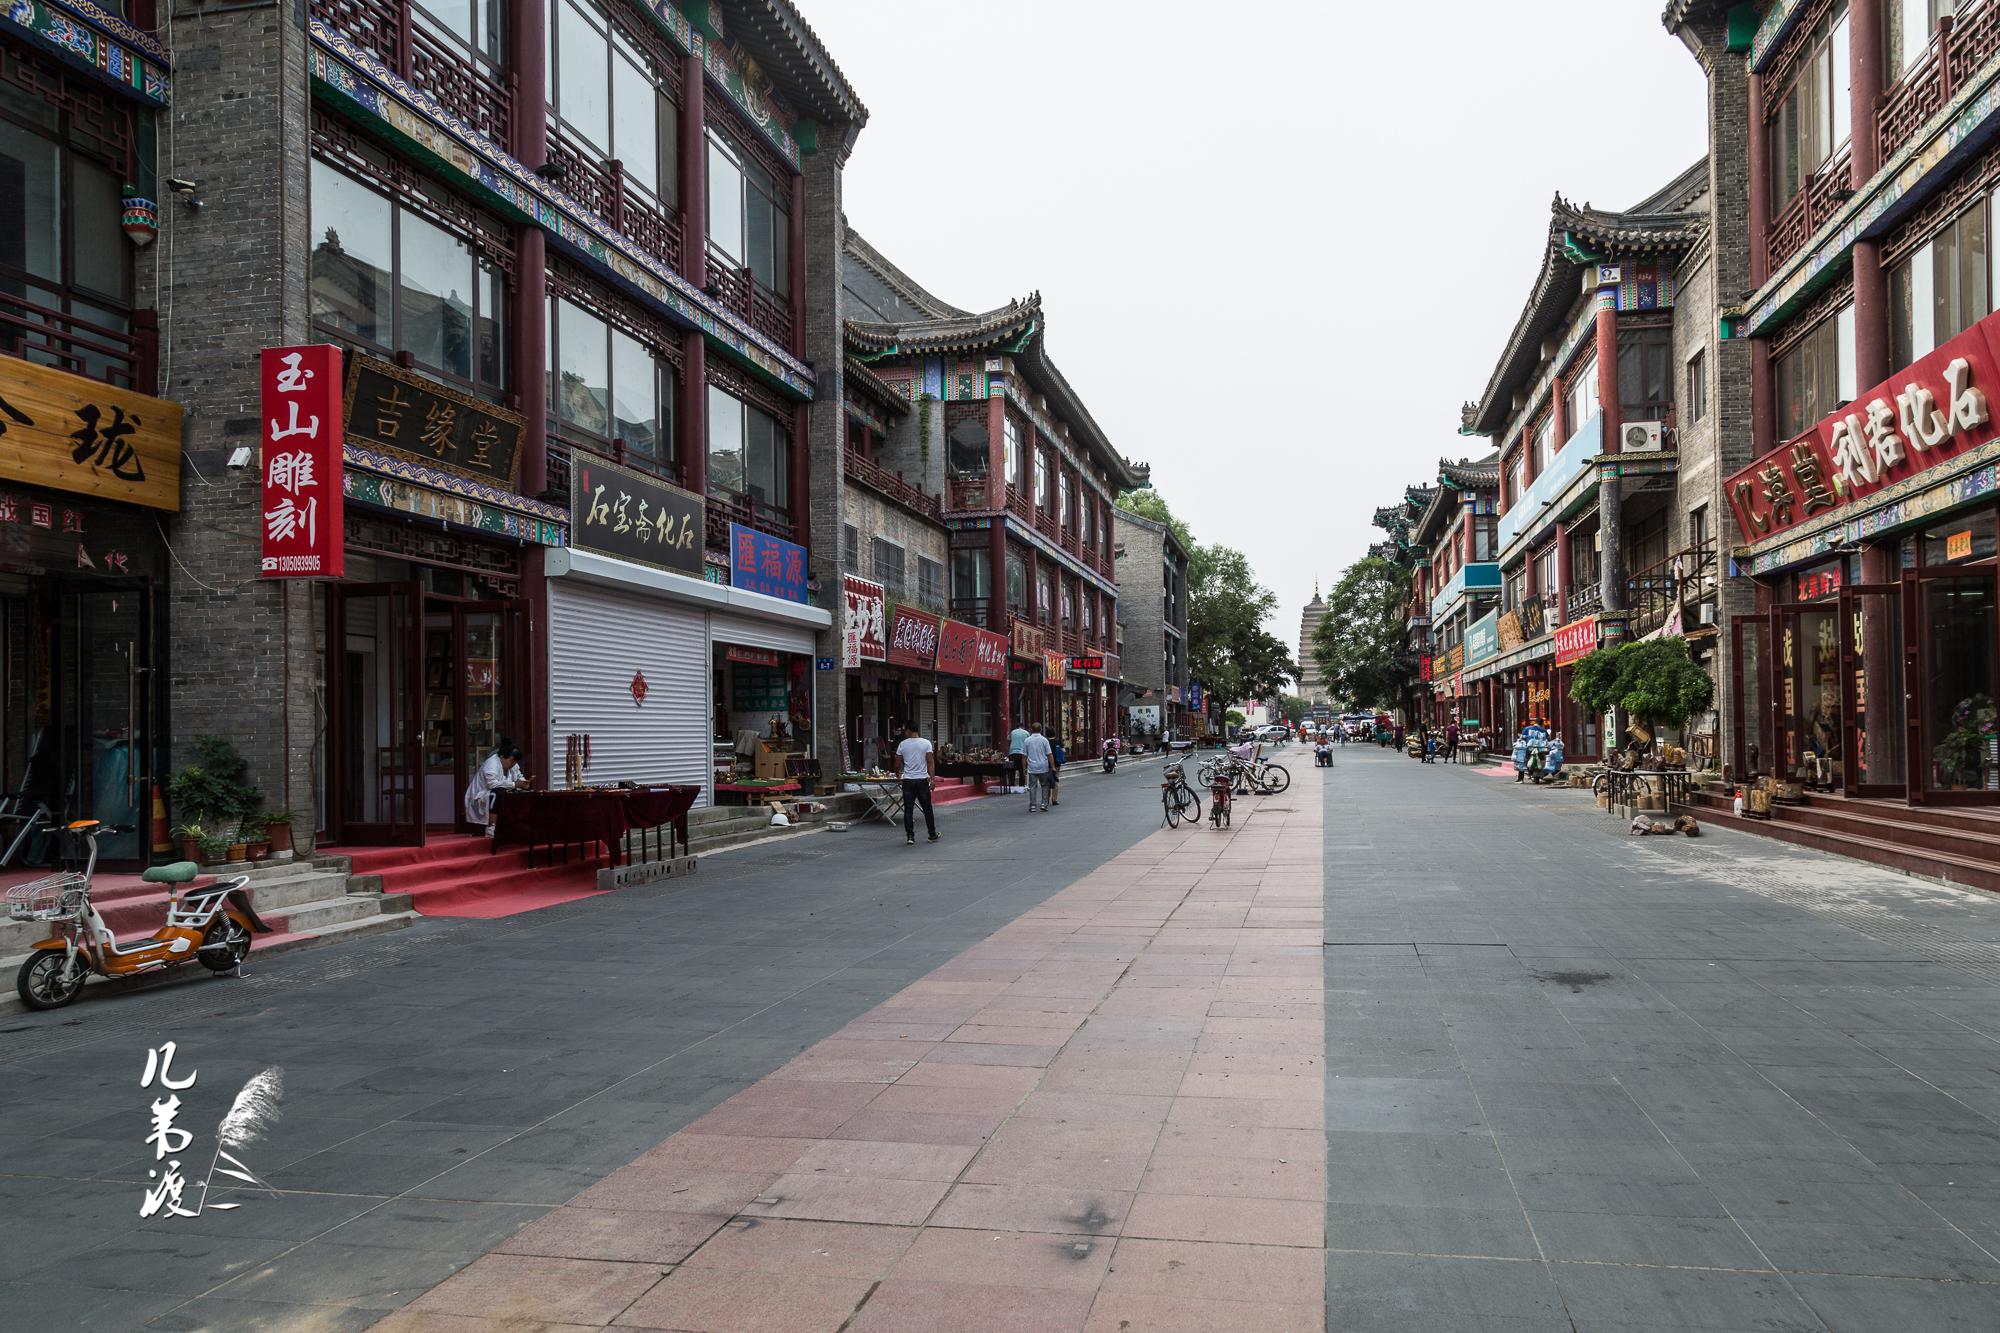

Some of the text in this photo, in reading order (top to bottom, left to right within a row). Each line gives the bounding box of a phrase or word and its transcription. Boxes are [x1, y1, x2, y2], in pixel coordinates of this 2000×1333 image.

[0, 396, 146, 482] 珑
[264, 352, 319, 548] 玉山雕刻
[375, 384, 502, 470] 吉缘堂
[586, 484, 695, 551] 石宝斋化石
